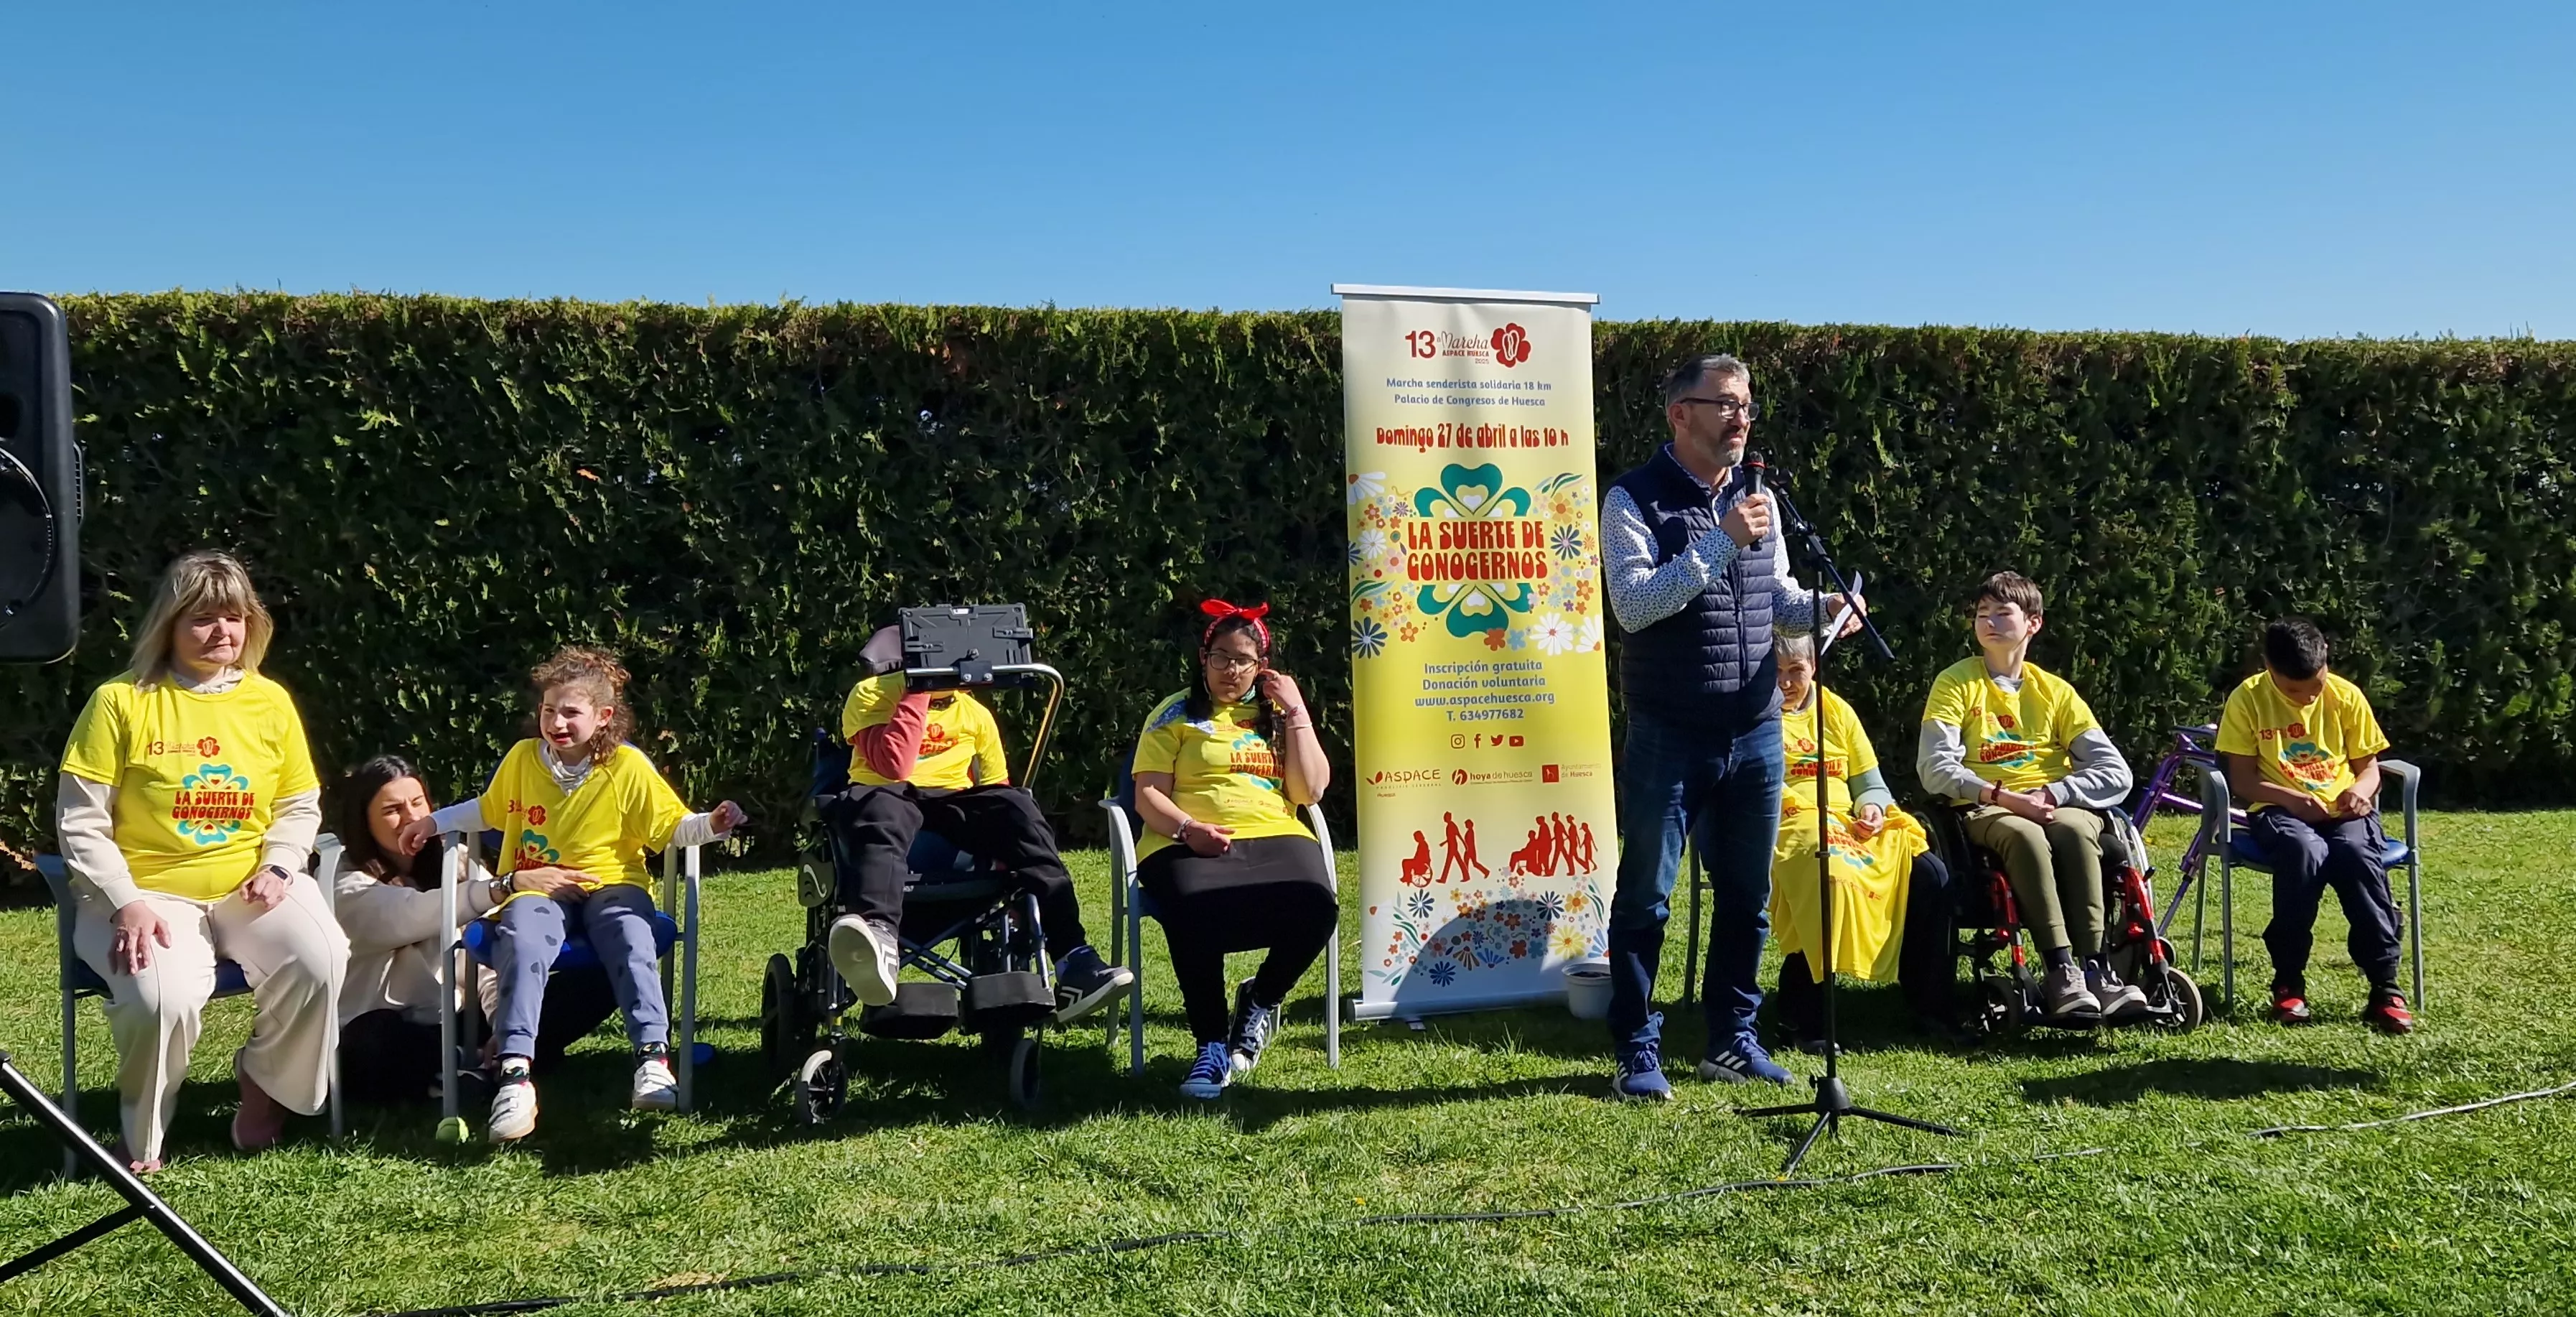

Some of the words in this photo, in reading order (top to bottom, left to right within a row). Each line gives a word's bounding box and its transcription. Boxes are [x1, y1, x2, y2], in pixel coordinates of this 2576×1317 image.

[1441, 331, 1489, 350] Marcha
[1386, 378, 1424, 388] Marcha
[1426, 379, 1478, 389] senderista
[1480, 379, 1521, 391] solidaria
[1523, 381, 1535, 391] 18
[1537, 381, 1551, 391] km
[1394, 394, 1429, 404] Palacio
[1432, 395, 1444, 404] de
[1446, 395, 1496, 407] Congresos
[1499, 396, 1509, 406] de
[1511, 396, 1545, 406] Huesca
[1376, 425, 1434, 452] Domingo
[1437, 422, 1452, 448] 27
[1456, 424, 1473, 448] de
[1477, 423, 1506, 448] abril
[1510, 429, 1518, 448] a
[1521, 425, 1540, 447] las
[1543, 428, 1557, 447] 10
[1560, 429, 1569, 447] h
[1408, 522, 1433, 550] LA
[1439, 521, 1515, 549] SUERTE
[1522, 521, 1544, 549] DE
[1424, 661, 1489, 676] Inscripción
[1492, 660, 1543, 674] gratuita
[1422, 676, 1478, 690] Donación
[1481, 675, 1546, 688] voluntaria
[1415, 692, 1554, 707] www.aspacehuesca.org
[1447, 711, 1457, 722] T.
[1460, 709, 1524, 721] 634977682
[147, 741, 164, 755] 13
[1230, 752, 1242, 763] LA
[1244, 752, 1277, 764] SUERT
[1385, 769, 1442, 783] ASPACE
[175, 791, 191, 806] LA
[195, 791, 239, 806] SUERTE
[242, 792, 256, 806] DE
